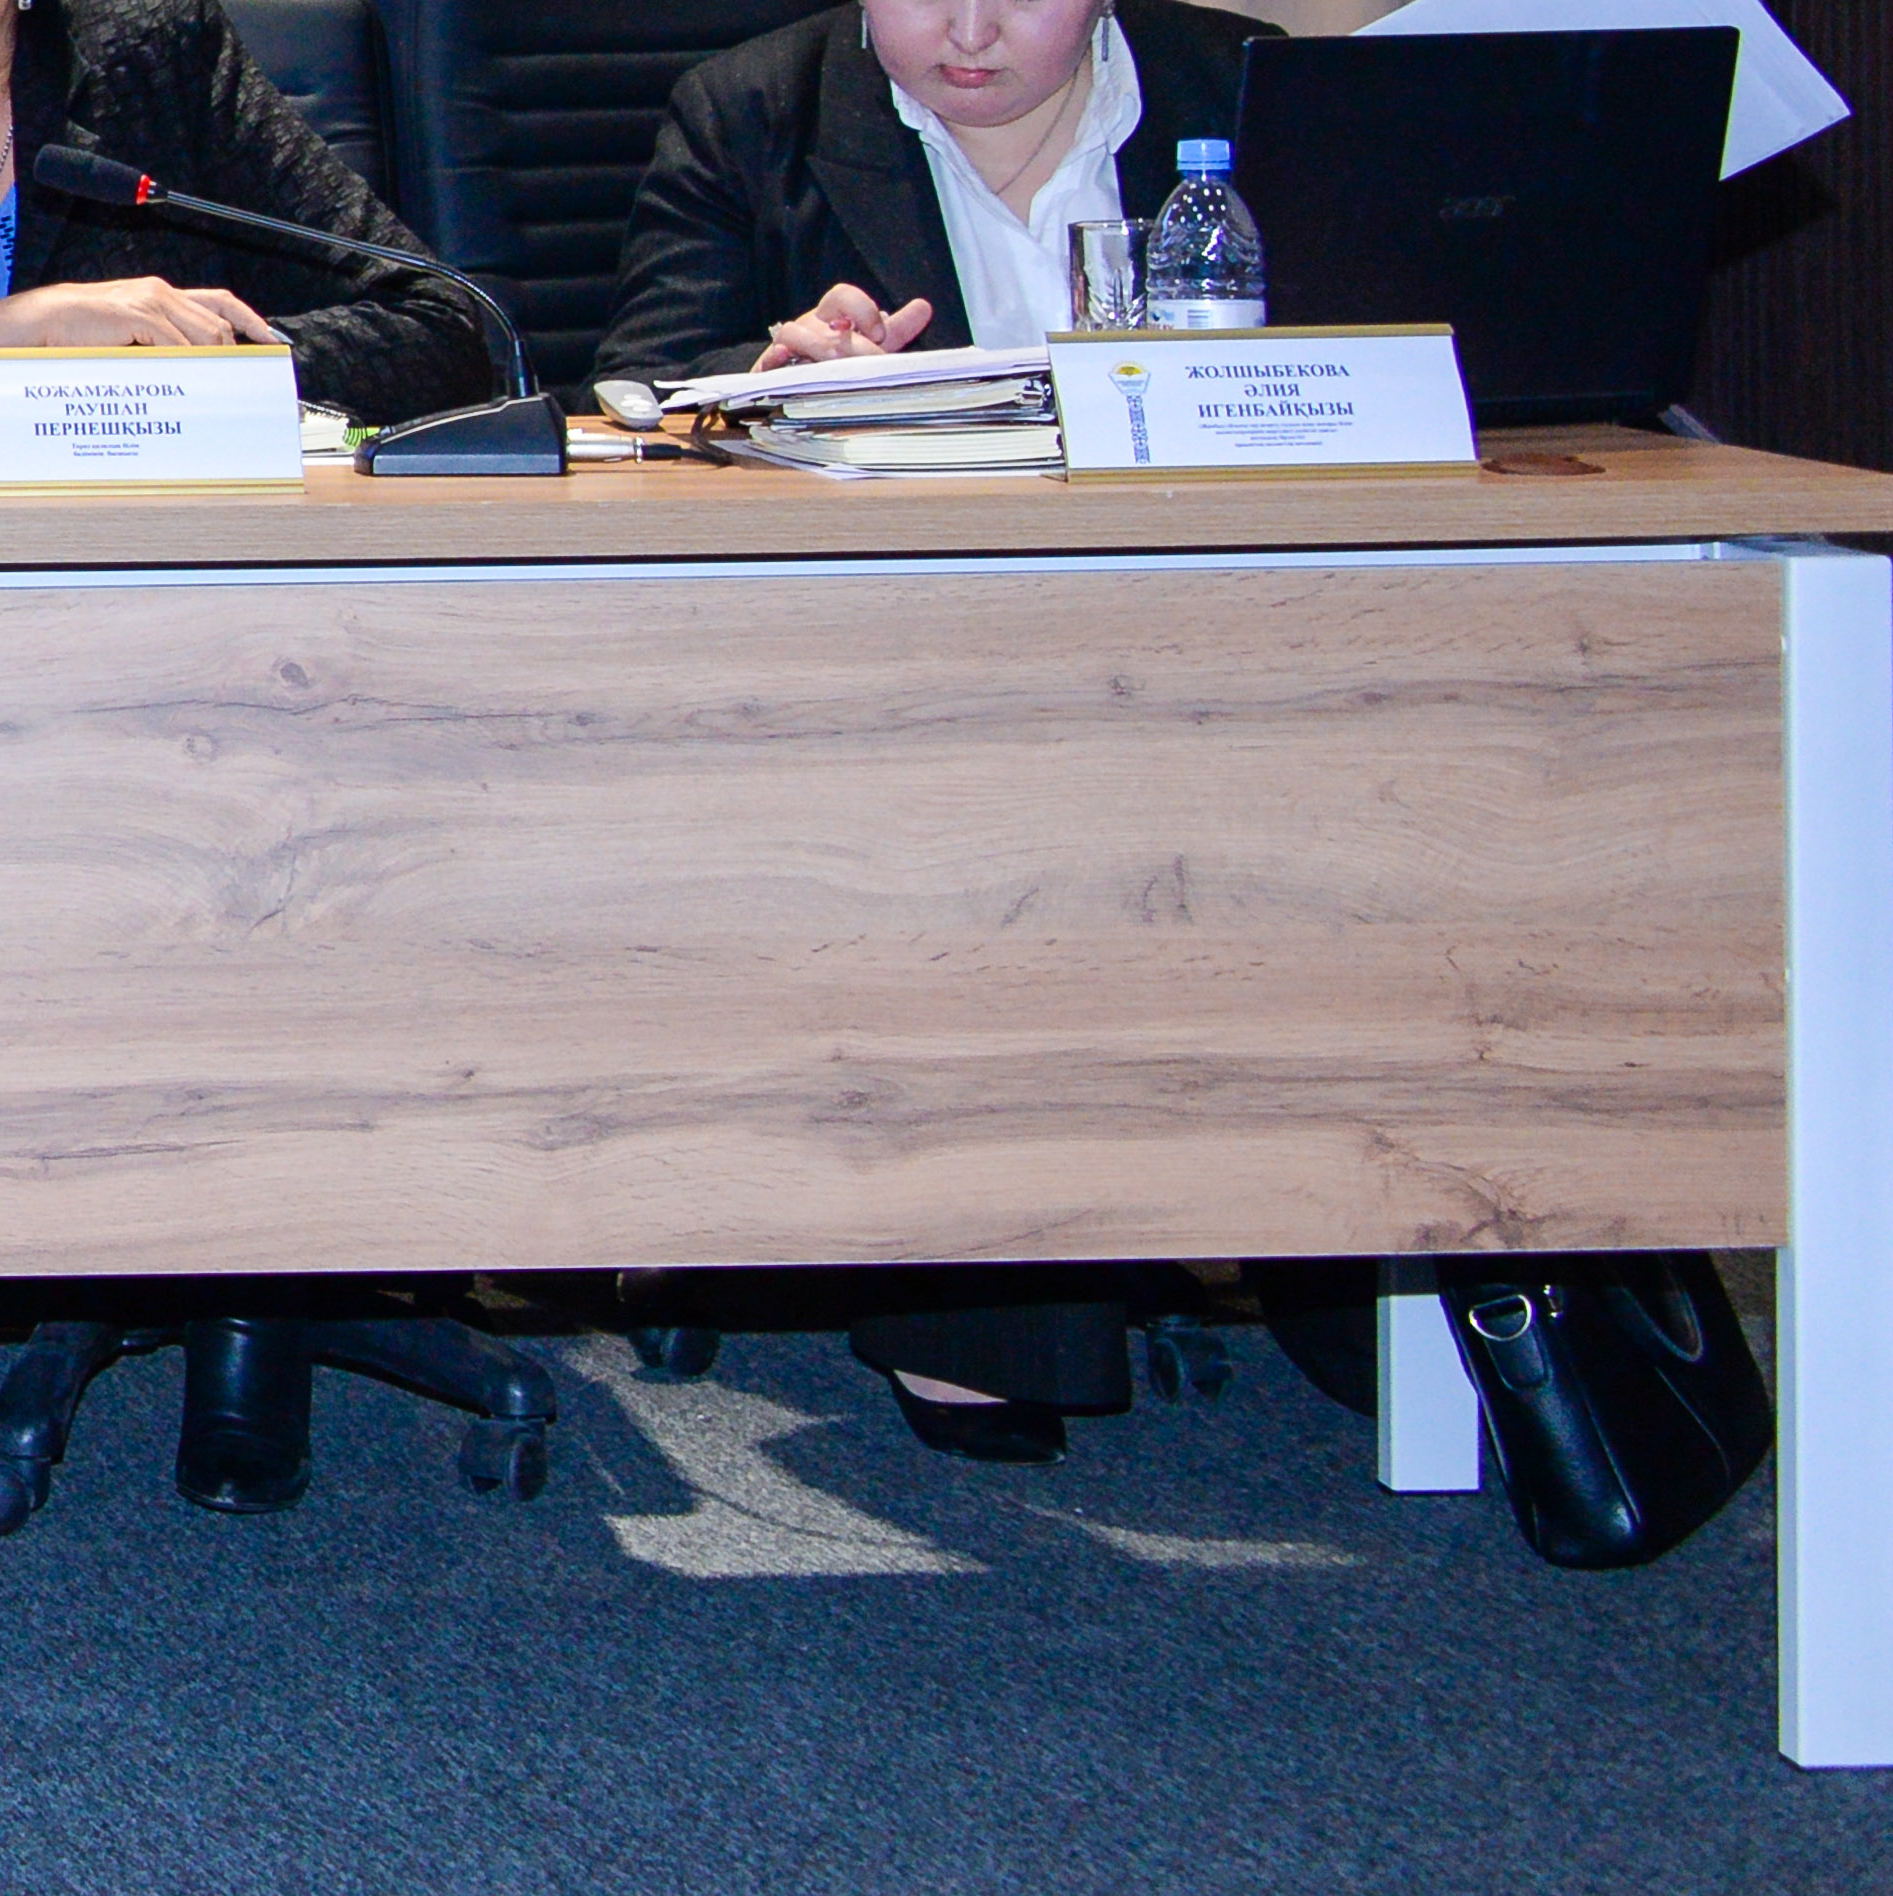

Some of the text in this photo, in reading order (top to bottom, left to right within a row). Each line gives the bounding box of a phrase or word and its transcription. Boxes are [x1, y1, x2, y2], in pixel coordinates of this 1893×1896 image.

[1185, 363, 1351, 379] ЖОЛШЫБЕКОВА
[24, 384, 186, 400] ҚОЖАМЖАРОВА
[1244, 383, 1301, 397] ӘЛИЯ
[65, 402, 148, 416] РАУШАН
[1198, 400, 1355, 418] ИГЕНБАЙҚЫЗЫ
[34, 421, 182, 437] ПЕРНЕШҚЫЗЫ
